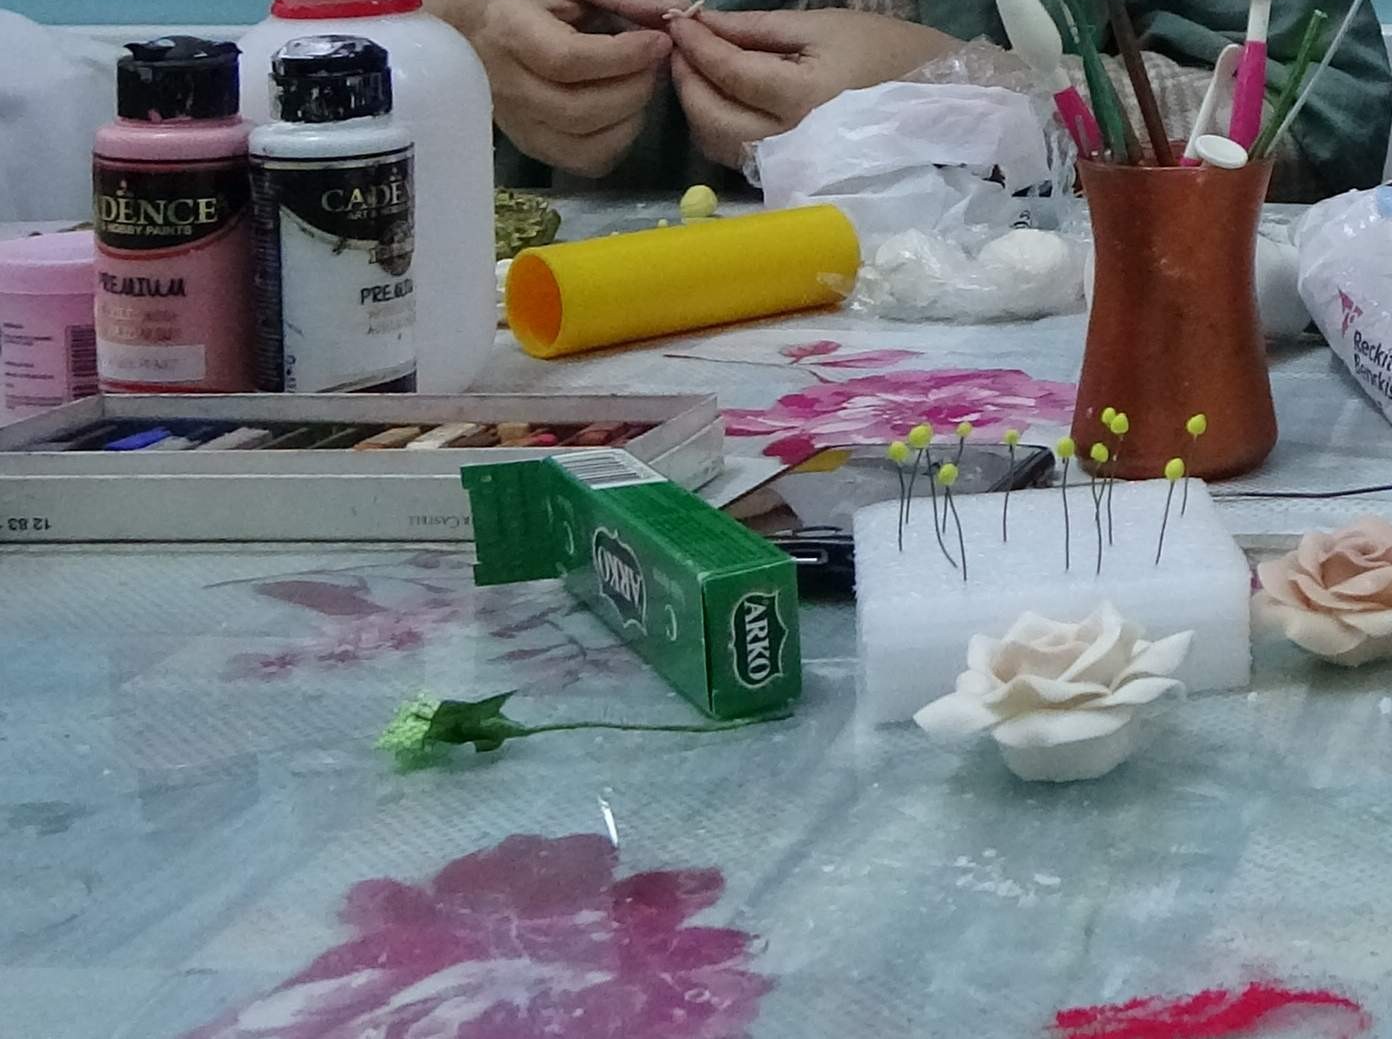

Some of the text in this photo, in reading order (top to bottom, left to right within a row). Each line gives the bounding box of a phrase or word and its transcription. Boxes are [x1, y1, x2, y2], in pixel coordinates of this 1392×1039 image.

[98, 195, 218, 225] DENCE
[32, 517, 52, 531] 12
[597, 545, 642, 608] ARKO
[743, 600, 771, 681] ARKO
